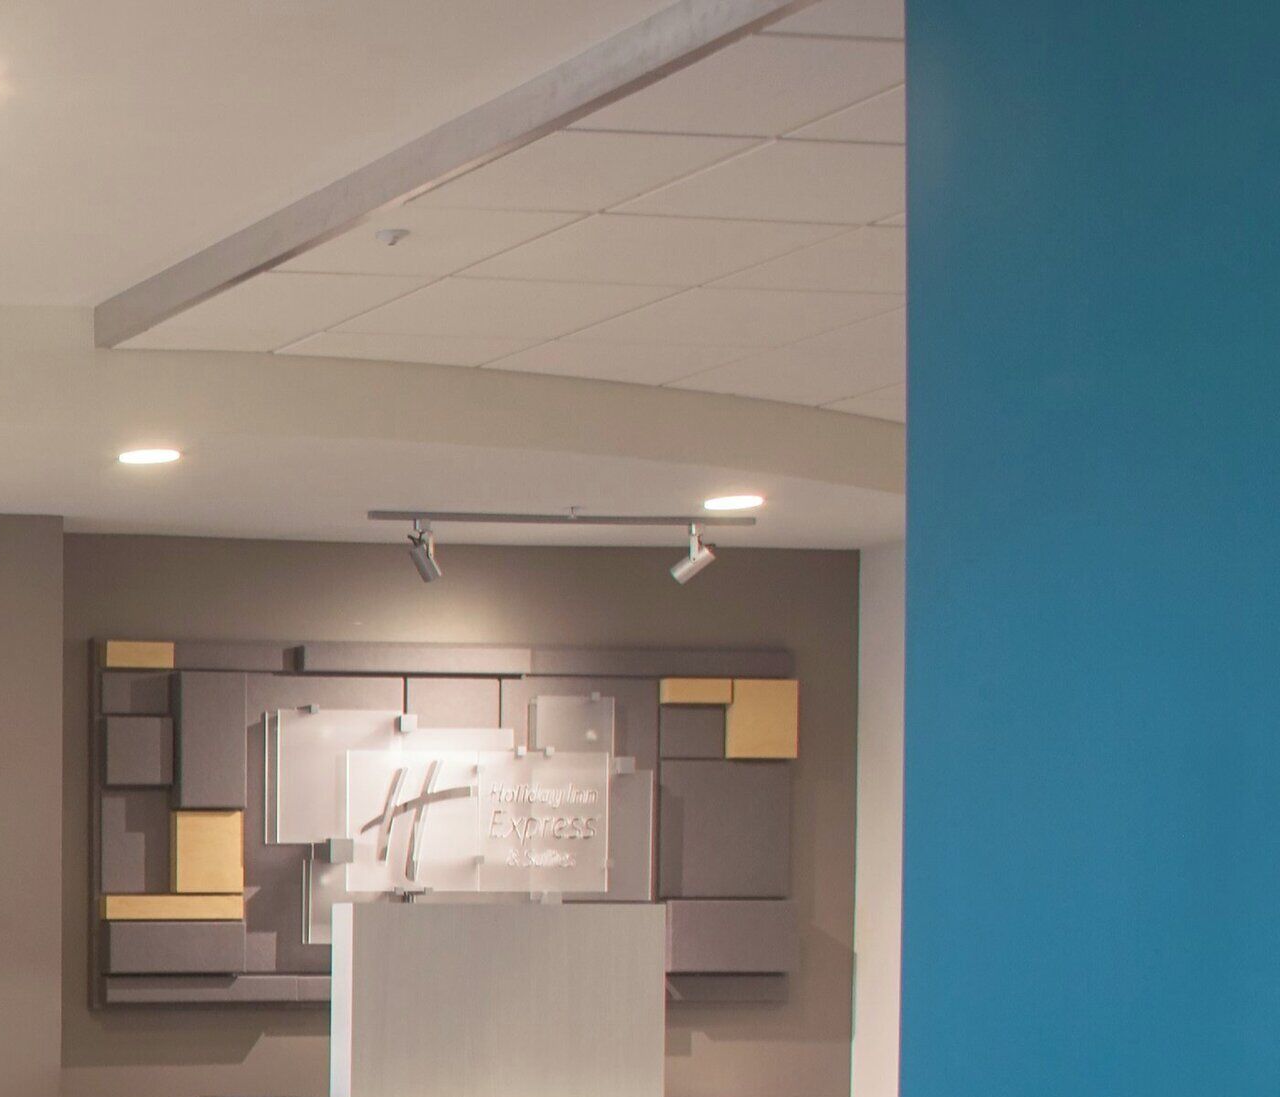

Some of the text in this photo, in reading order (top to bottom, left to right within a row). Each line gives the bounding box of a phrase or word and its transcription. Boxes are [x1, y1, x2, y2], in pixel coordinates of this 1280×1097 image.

[490, 783, 598, 809] Holiday Inn
[489, 808, 597, 846] Express
